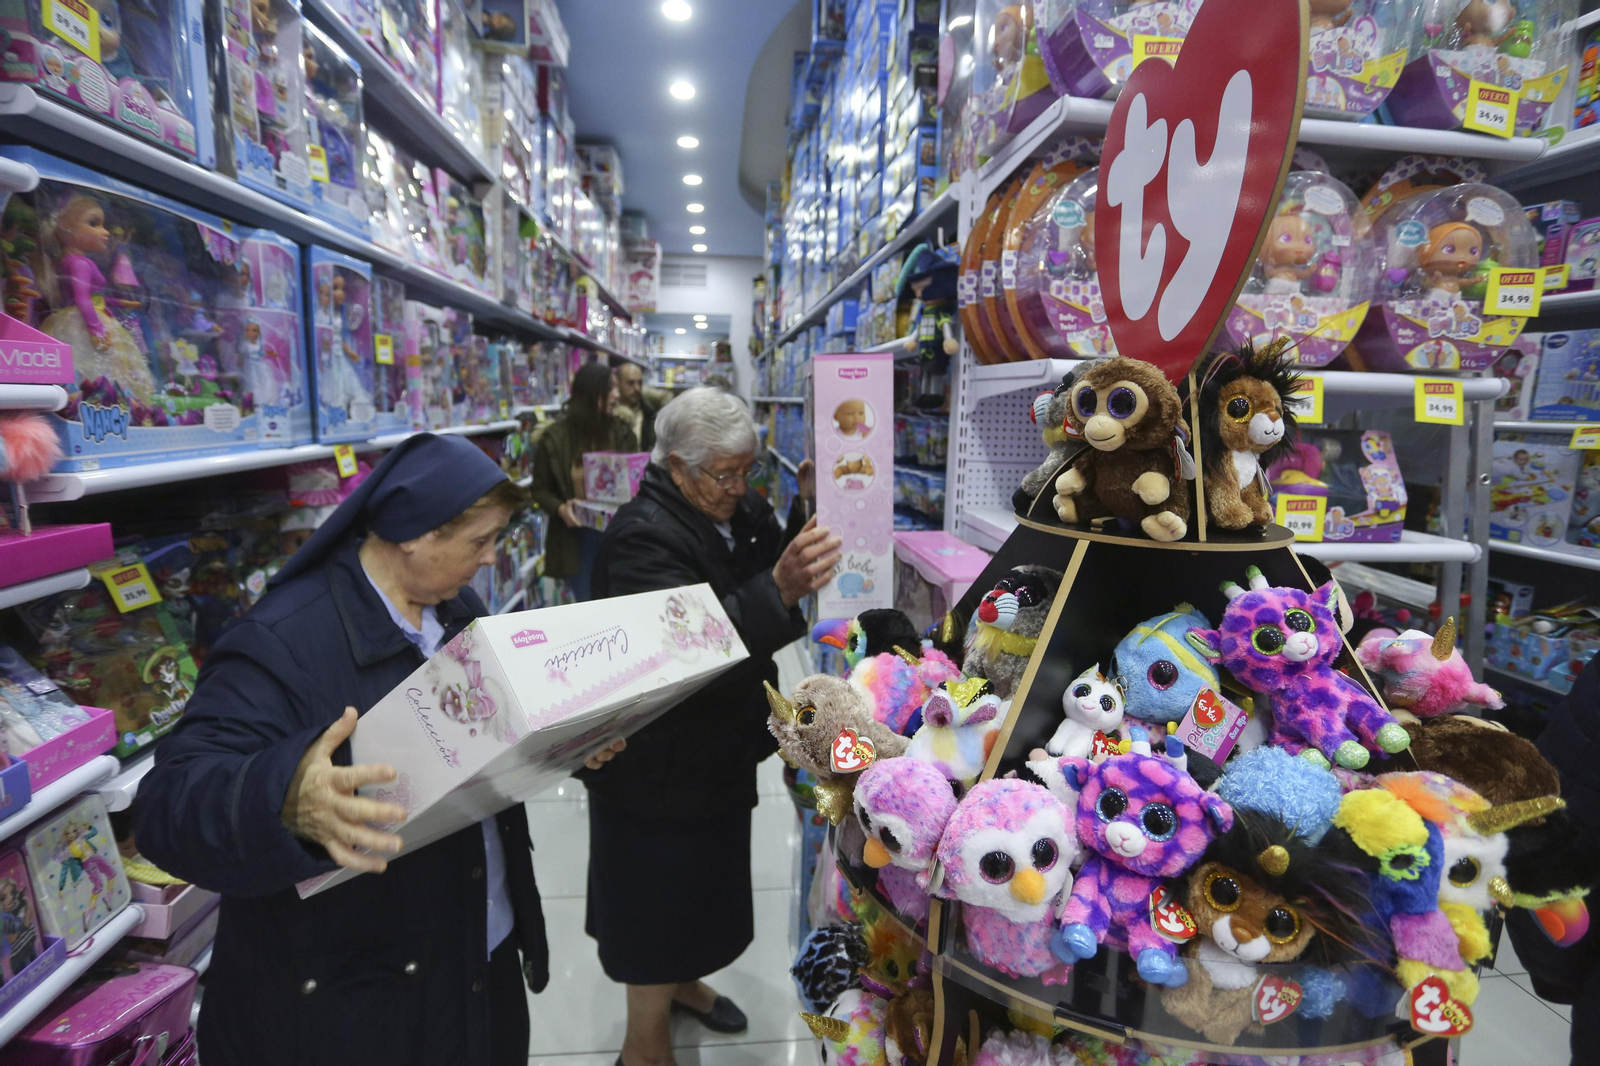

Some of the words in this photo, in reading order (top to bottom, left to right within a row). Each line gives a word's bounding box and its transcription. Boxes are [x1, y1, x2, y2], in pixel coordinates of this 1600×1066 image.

[1479, 89, 1509, 104] OFERTA
[1479, 110, 1504, 124] 34,99
[1107, 70, 1252, 342] ty
[1501, 273, 1534, 284] OFERTA
[1501, 295, 1530, 304] 34,99
[1425, 384, 1454, 394] OFERTA
[1428, 404, 1453, 412] 34,99
[80, 401, 129, 443] NANCY
[1287, 500, 1317, 511] OFERTA
[514, 633, 545, 644] RosaToys
[544, 628, 628, 672] Colección
[407, 687, 454, 768] Colección
[836, 736, 860, 769] ty
[1260, 985, 1287, 1021] ty
[1414, 984, 1451, 1033] ty
